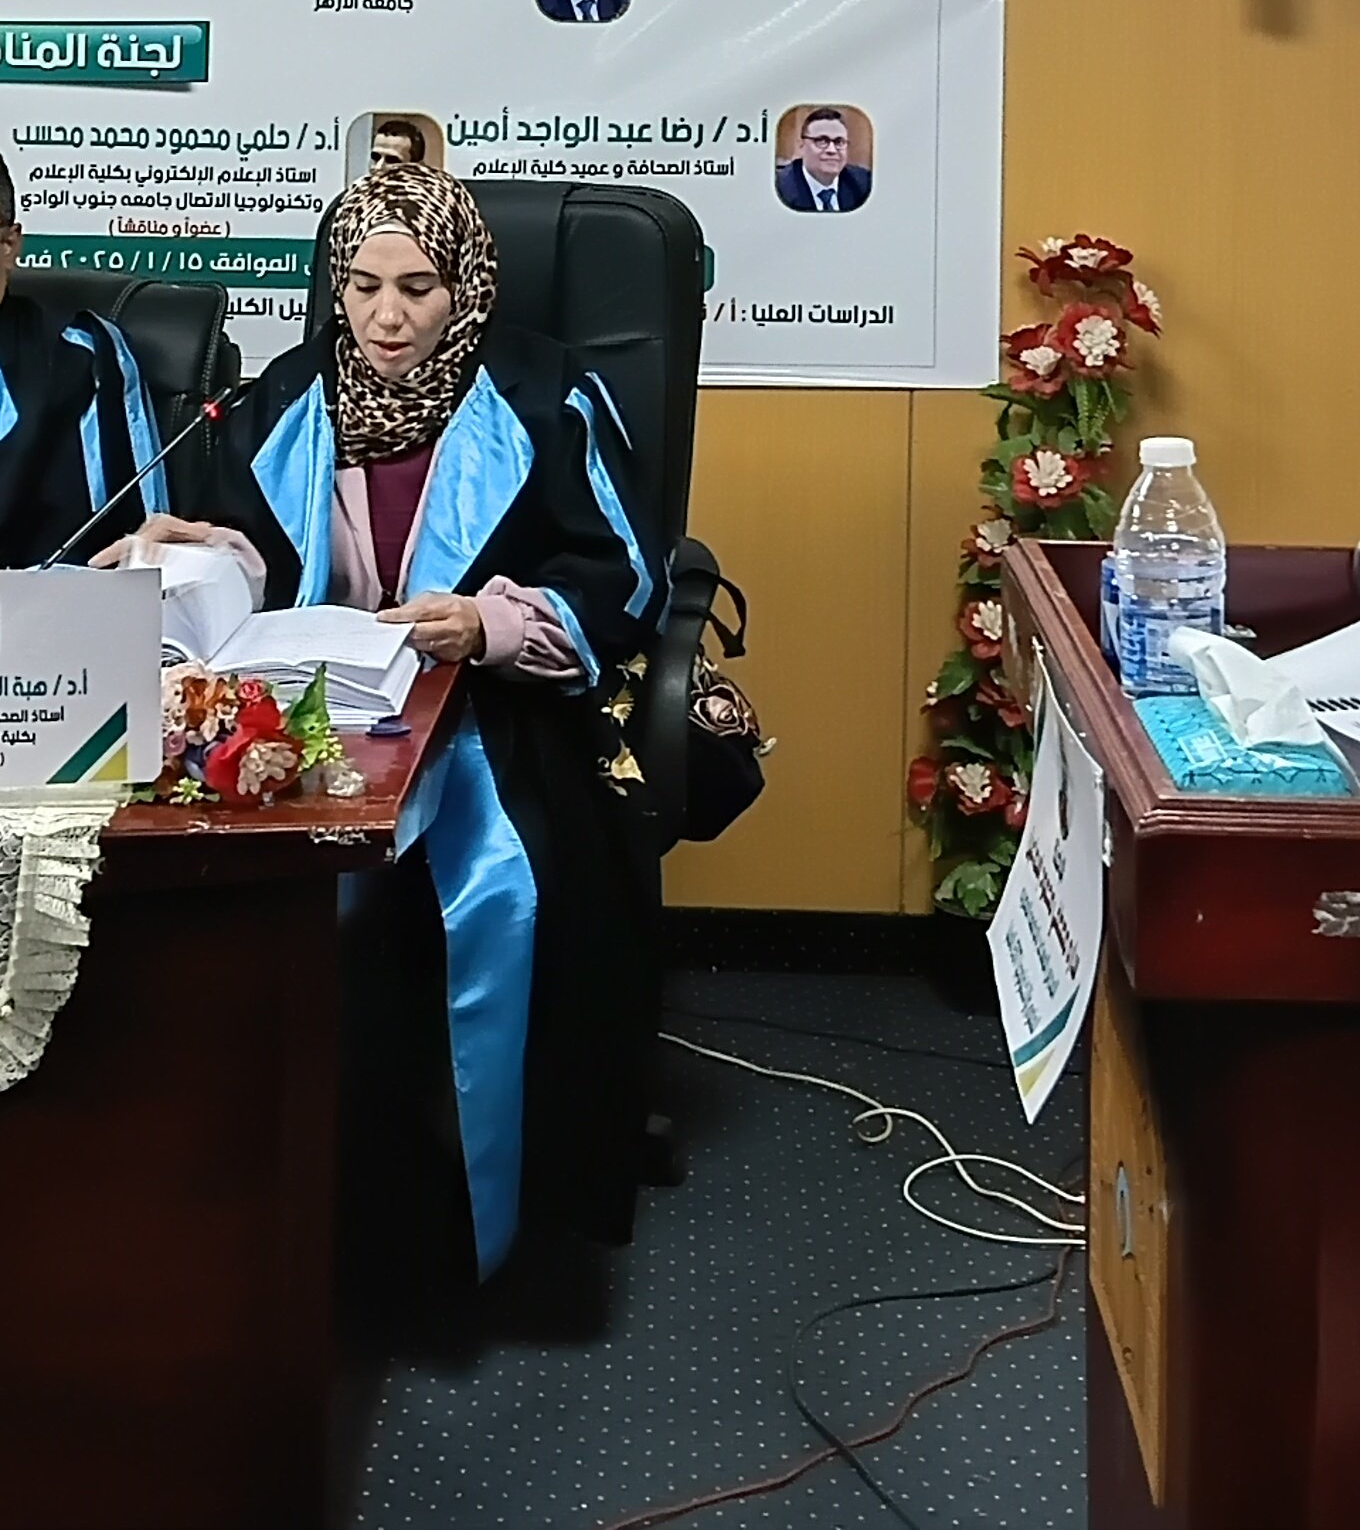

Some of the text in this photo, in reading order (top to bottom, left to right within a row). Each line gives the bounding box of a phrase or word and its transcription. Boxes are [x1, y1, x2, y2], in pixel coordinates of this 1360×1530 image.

[97, 33, 183, 77] لجنة
[89, 126, 150, 150] محمد
[155, 128, 231, 155] محمود
[236, 123, 290, 162] حلمي
[314, 116, 340, 151] أ.د
[446, 106, 768, 149] أ.د رضا عبد الواجد أمين
[751, 303, 894, 328] الدراسات العليا
[11, 674, 49, 702] هبة
[66, 667, 89, 697] أ.د
